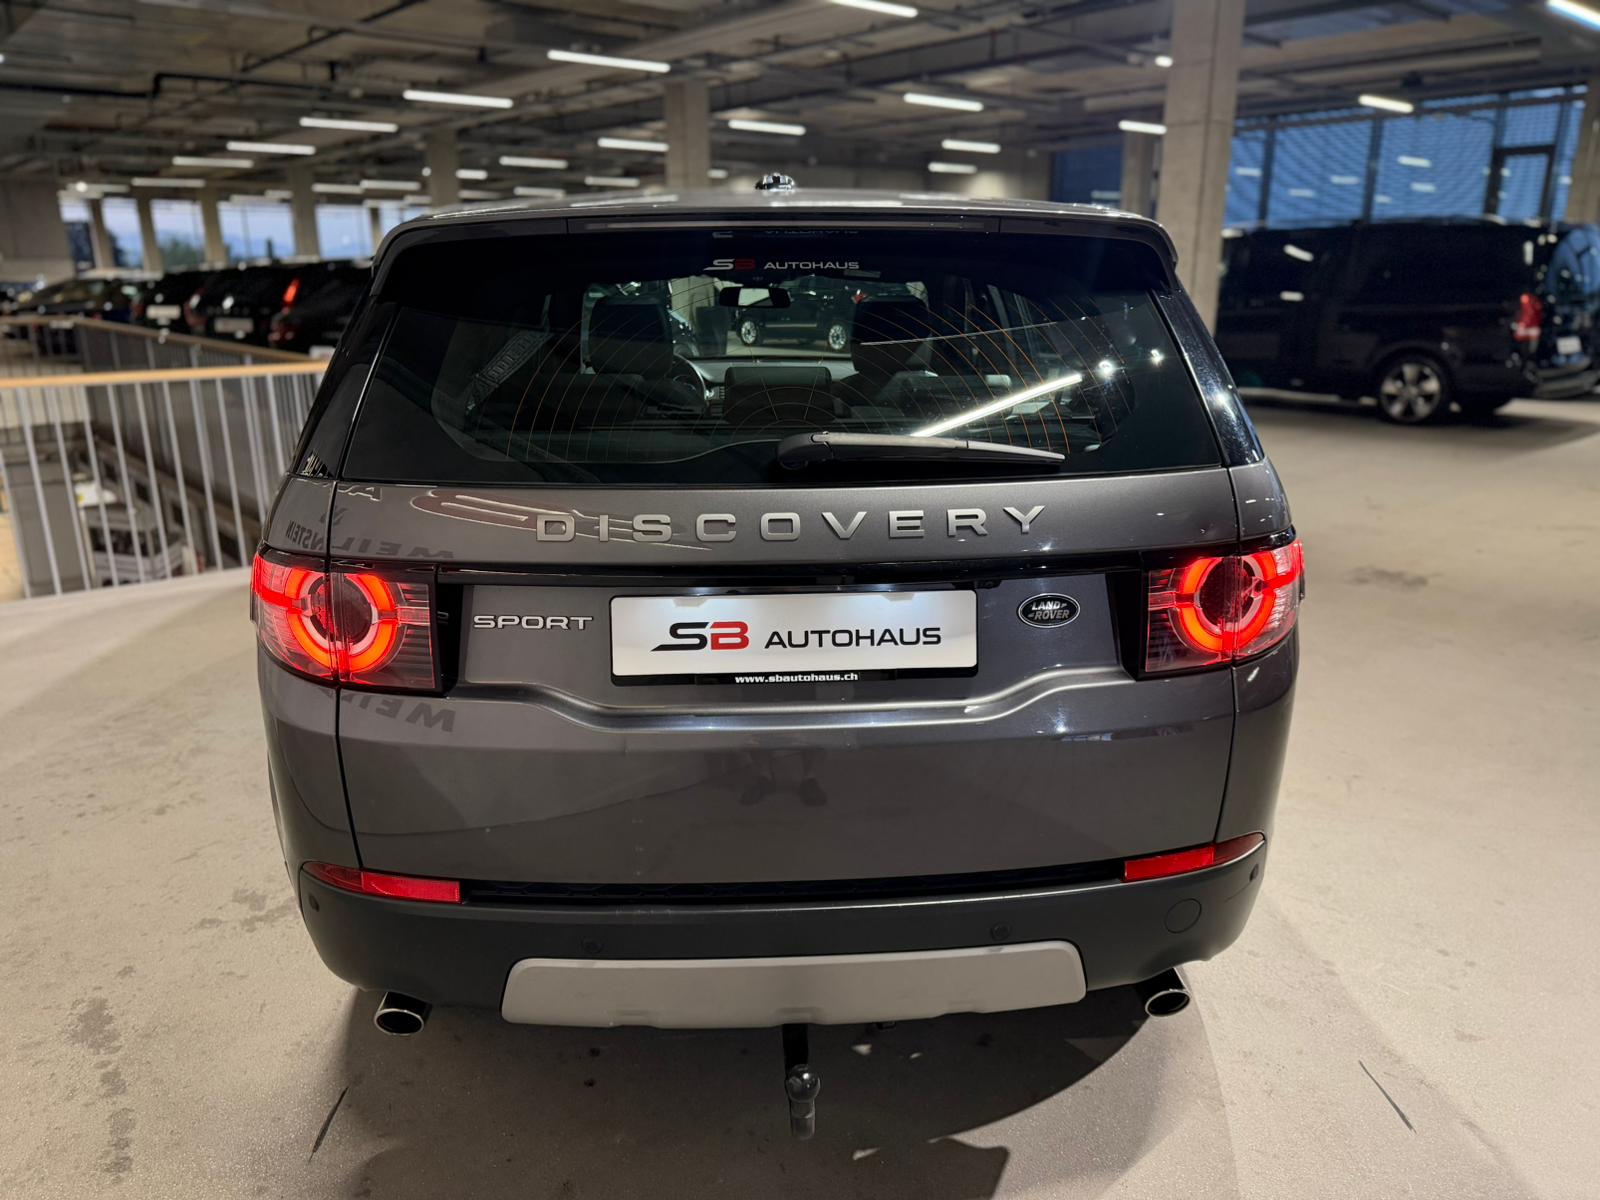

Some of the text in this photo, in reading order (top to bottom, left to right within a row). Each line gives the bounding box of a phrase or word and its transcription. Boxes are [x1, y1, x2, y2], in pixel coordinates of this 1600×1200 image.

[703, 258, 860, 272] SB AUTOHAUS
[536, 505, 1046, 542] DISCOVERY
[1031, 600, 1061, 611] LAND
[1034, 609, 1070, 620] ROVER
[473, 615, 593, 630] SPORT
[650, 620, 942, 651] SB AUTOHAUS
[734, 672, 860, 684] www.sbautohaus.ch
